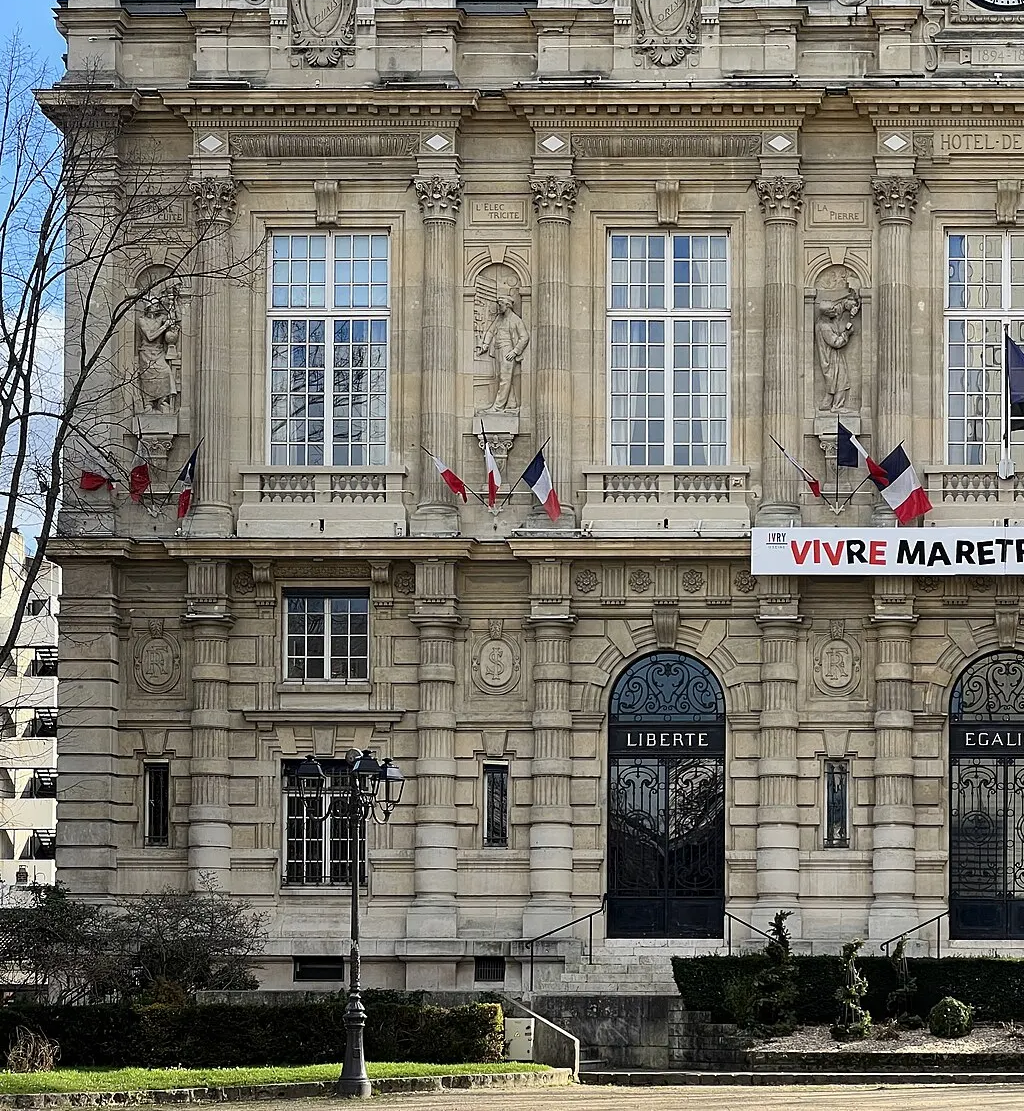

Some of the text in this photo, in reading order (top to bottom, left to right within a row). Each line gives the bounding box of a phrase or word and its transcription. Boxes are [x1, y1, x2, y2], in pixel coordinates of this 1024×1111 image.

[830, 211, 860, 220] PIERRE
[768, 533, 786, 543] IVRY
[790, 539, 887, 565] VIVRE
[896, 539, 952, 567] MA
[626, 733, 708, 747] LIBERTE
